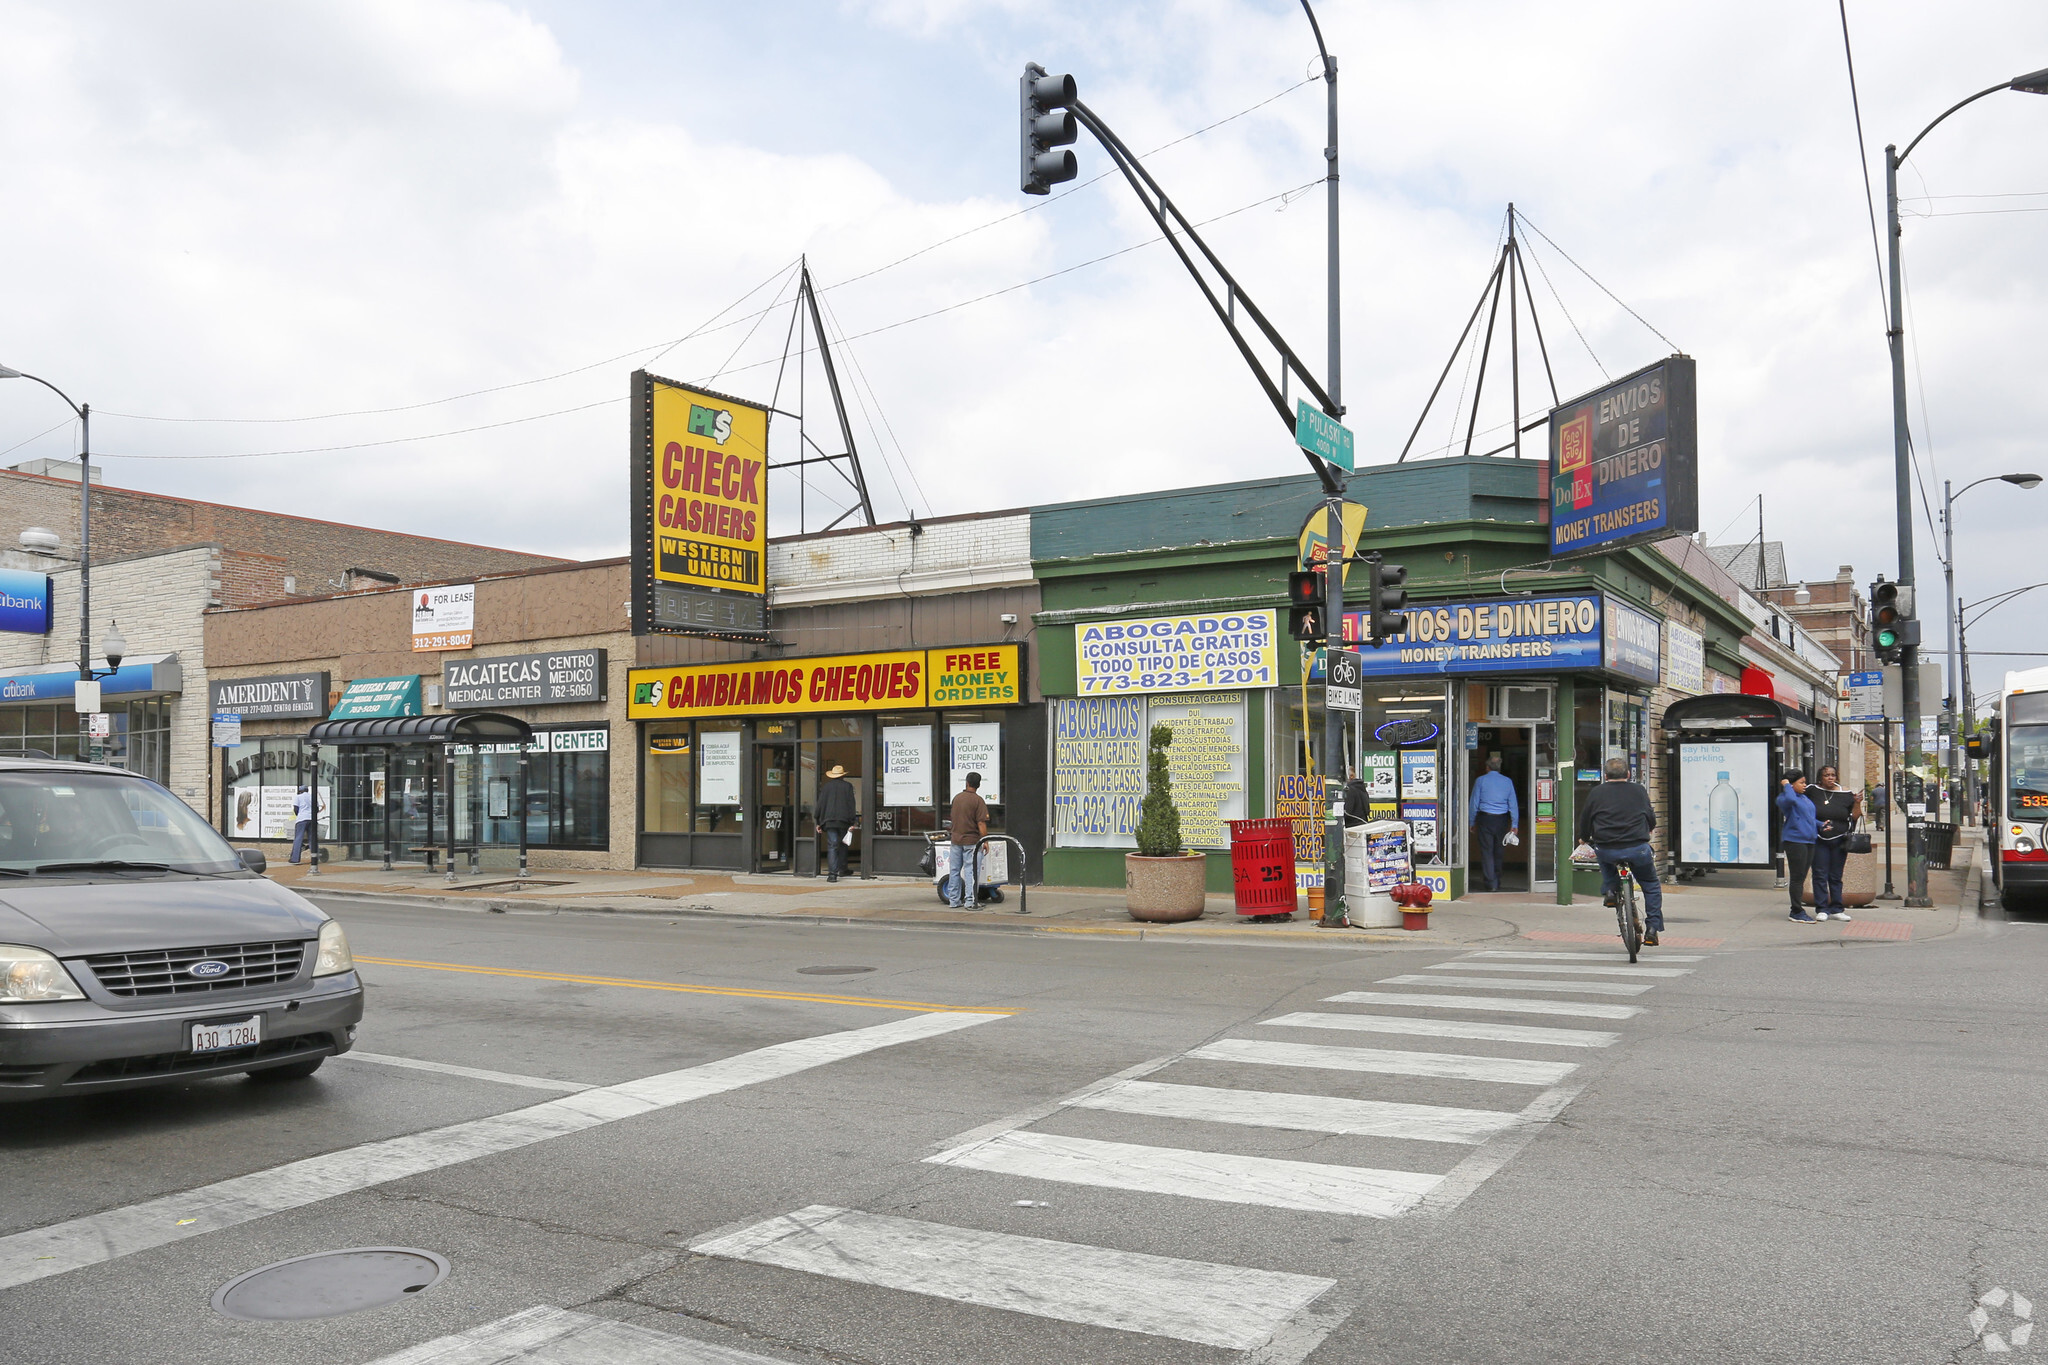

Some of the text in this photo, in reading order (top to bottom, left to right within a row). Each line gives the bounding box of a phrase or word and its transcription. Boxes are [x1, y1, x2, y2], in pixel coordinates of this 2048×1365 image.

[1600, 378, 1661, 425] ENVIOS
[1301, 410, 1306, 423] S
[1309, 412, 1341, 446] PULASKI
[1618, 417, 1639, 448] DE
[1316, 438, 1330, 454] 4000
[1599, 443, 1662, 486] DINERO
[661, 441, 762, 505] CHECK
[1555, 479, 1592, 507] DolEx
[658, 494, 757, 542] CASHERS
[1555, 498, 1660, 546] MONEY TRANSFERS
[660, 537, 743, 566] WESTERN
[687, 558, 743, 581] UNION
[434, 592, 473, 605] FOR LEASE
[1457, 607, 1491, 640] DE
[1497, 599, 1596, 638] DINERO
[1082, 615, 1268, 642] ABOGADOS
[414, 634, 472, 649] 312-291-8047
[1083, 632, 1269, 659] ¡CONSULTA GRATIS!
[1669, 626, 1702, 651] ABOGADOS
[1400, 641, 1553, 664] MONEY TRANSFERS
[547, 653, 595, 670] CENTRO
[945, 651, 1001, 672] FREE
[1091, 650, 1261, 674] TODO TIPO DE CASOS
[448, 659, 541, 687] ZACATECAS
[549, 668, 594, 684] MEDICO
[940, 671, 1008, 687] MONEY
[1082, 666, 1269, 691] 773-823-1201
[3, 681, 36, 698] citibank
[217, 680, 301, 706] AMERIDENT
[346, 682, 387, 694] ZACATECAS
[384, 681, 405, 692] FOOT
[550, 683, 593, 698] 762-5050
[667, 661, 921, 709] CAMBIAMOS CHEQUES
[933, 685, 1014, 701] ORDERS
[352, 693, 393, 703] MEDICAL CENTER
[448, 685, 542, 703] MEDICAL CENTER
[1203, 694, 1241, 704] GRATIS!
[1328, 689, 1360, 706] BIKE LANE
[232, 705, 249, 714] CENTER
[249, 704, 273, 713] 277-0200
[273, 703, 291, 713] CENTRO
[292, 702, 314, 711] DENTISTA
[1188, 709, 1200, 717] DUI
[1057, 697, 1140, 739] ABOGADOS
[1156, 719, 1192, 727] ACCIDENTE
[1203, 718, 1234, 726] TRABAJO
[554, 731, 605, 750] CENTER
[957, 736, 973, 744] GET
[1382, 718, 1432, 747] OPEN
[673, 738, 686, 747] WU
[891, 740, 905, 748] TAX
[979, 744, 995, 752] TAX
[1198, 745, 1207, 753] DE
[1208, 745, 1241, 753] MENORES
[1682, 745, 1721, 754] say hi to
[890, 748, 919, 757] CHECKS
[957, 753, 988, 761] REFUND
[1106, 741, 1140, 765] GRATIS!
[1364, 753, 1395, 767] MÉXICO
[1402, 755, 1435, 765] EL SALVADOR
[1682, 754, 1726, 764] sparkling.
[890, 757, 920, 765] CASHED
[957, 761, 988, 770] FASTER.
[1194, 763, 1232, 771] DOMESTICA
[890, 765, 912, 774] HERE.
[1055, 767, 1142, 793] TODO TIPO DE CASOS
[1203, 782, 1242, 790] AUTOMOVIL
[765, 810, 782, 819] OPEN
[1369, 809, 1396, 819] CUADOR
[1403, 808, 1436, 818] HONDURAS
[765, 819, 782, 830] 24/7
[1260, 865, 1283, 883] 25
[199, 964, 221, 974] Ford
[196, 1027, 257, 1051] A30 1284
